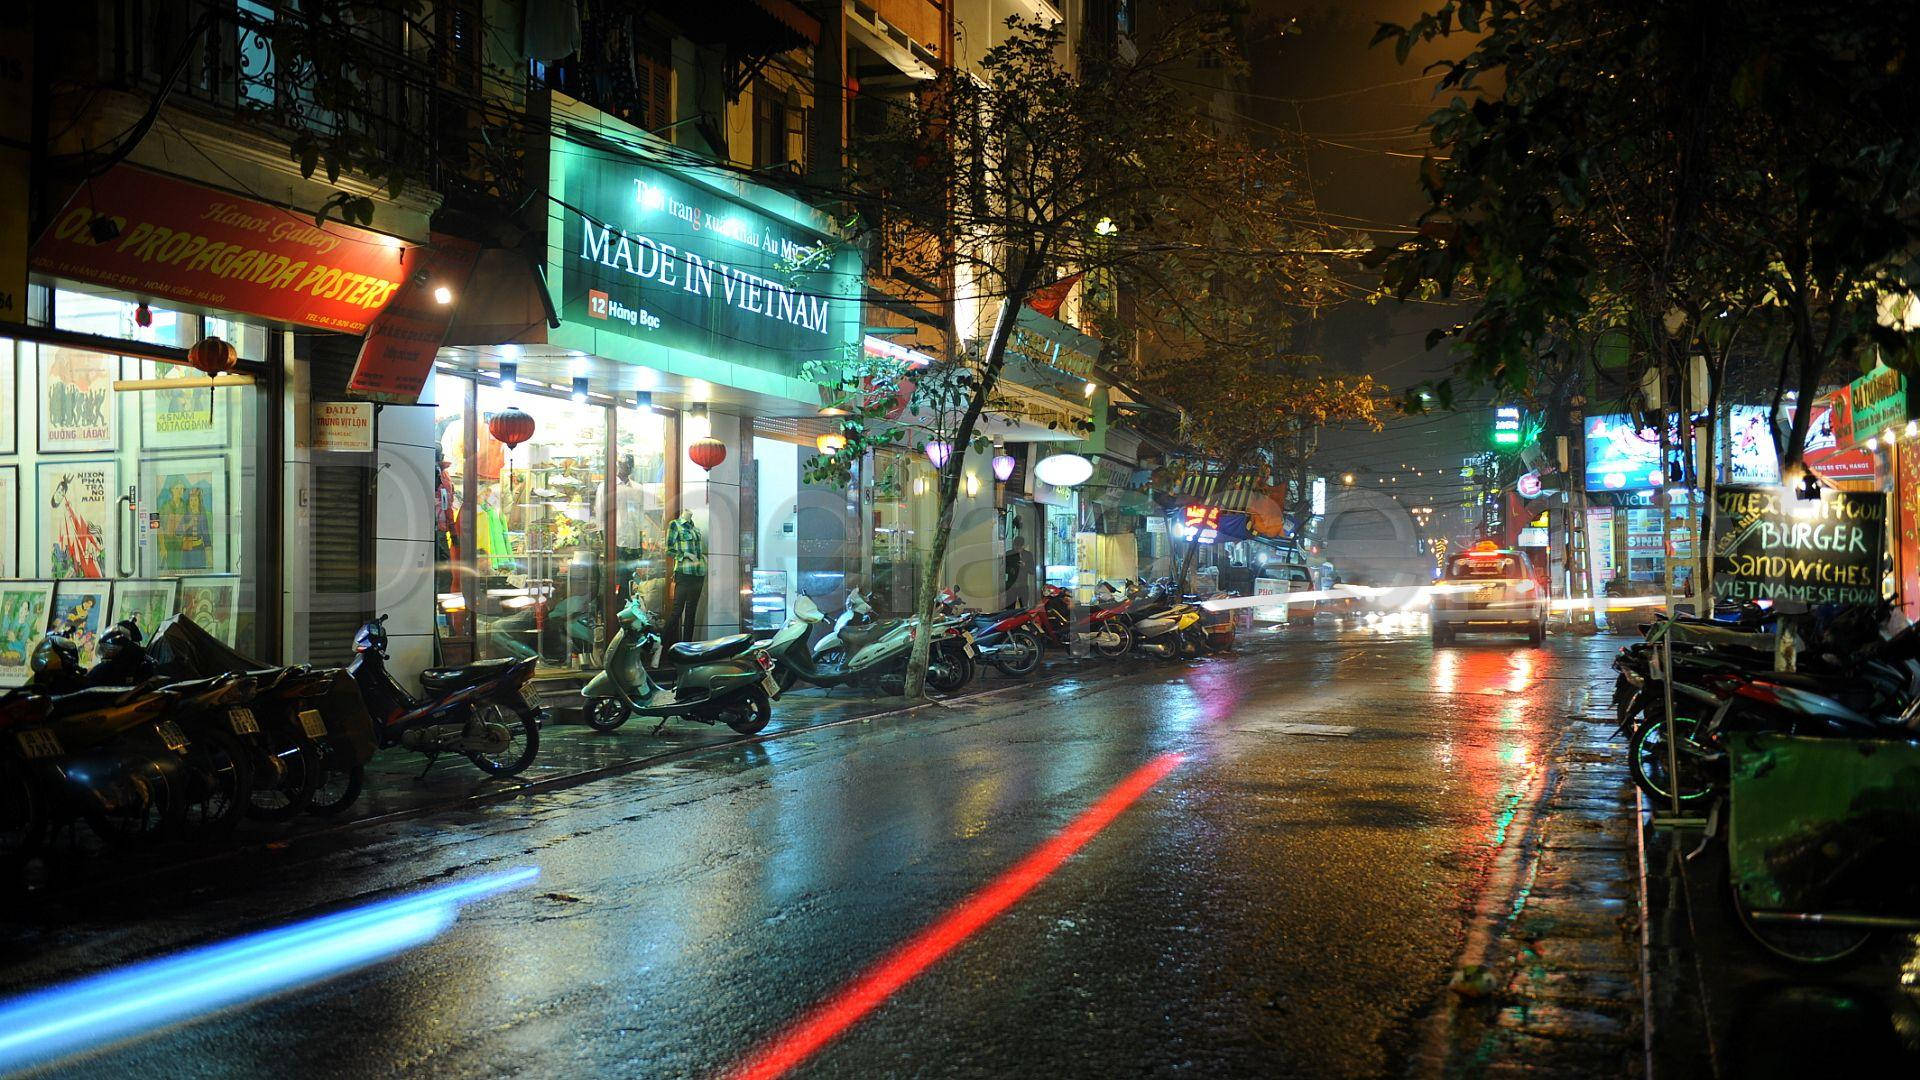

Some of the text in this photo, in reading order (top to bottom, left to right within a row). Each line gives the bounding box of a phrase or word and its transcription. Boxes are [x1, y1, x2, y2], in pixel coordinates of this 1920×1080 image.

[201, 201, 343, 256] Hanoi Gallery
[668, 196, 702, 231] trang
[762, 225, 778, 252] Âu
[115, 222, 308, 290] PROPAGANDA
[296, 265, 401, 310] POSTERS
[580, 215, 830, 335] MADE IN VIETNAM
[591, 297, 606, 315] 12
[608, 300, 638, 326] Hàng
[1760, 521, 1867, 554] BURGER
[1715, 580, 1878, 605] VIETNAMESE FOOD
